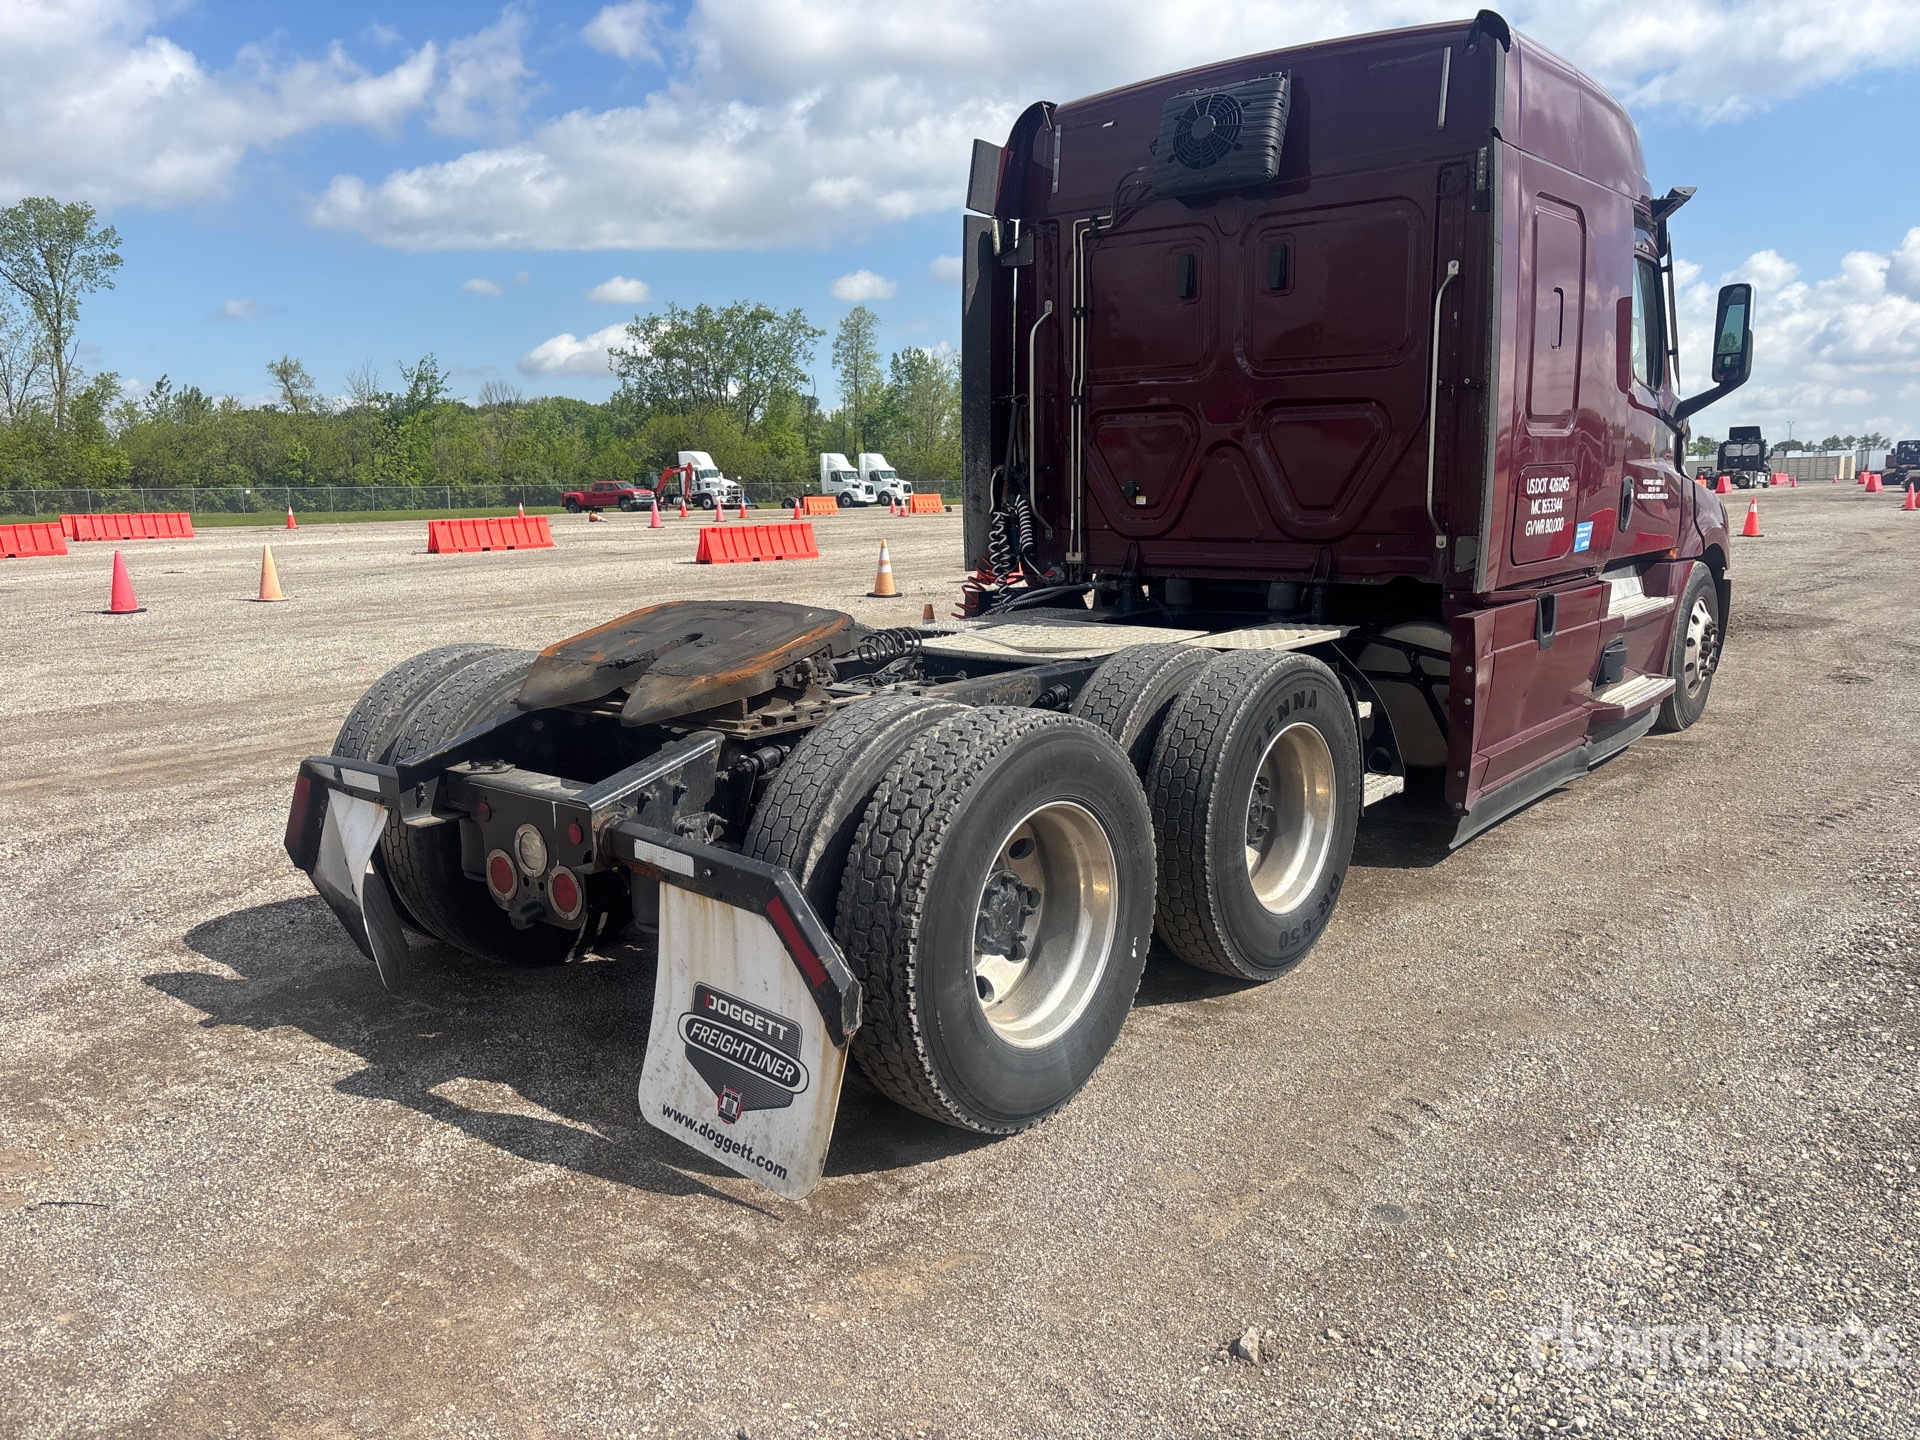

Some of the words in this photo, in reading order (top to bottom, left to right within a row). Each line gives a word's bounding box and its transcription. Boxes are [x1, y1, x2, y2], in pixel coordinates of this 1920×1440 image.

[1526, 477, 1548, 494] USDOT
[1530, 499, 1541, 515] MC
[1525, 518, 1544, 536] GVWR
[1545, 517, 1564, 534] 80,000
[1252, 689, 1318, 760] ZENNA
[1278, 871, 1341, 950] DR-850
[705, 993, 788, 1041] DOGGETT
[689, 1022, 795, 1082] FREIGHTLINER
[662, 1103, 788, 1180] www.doggett.com
